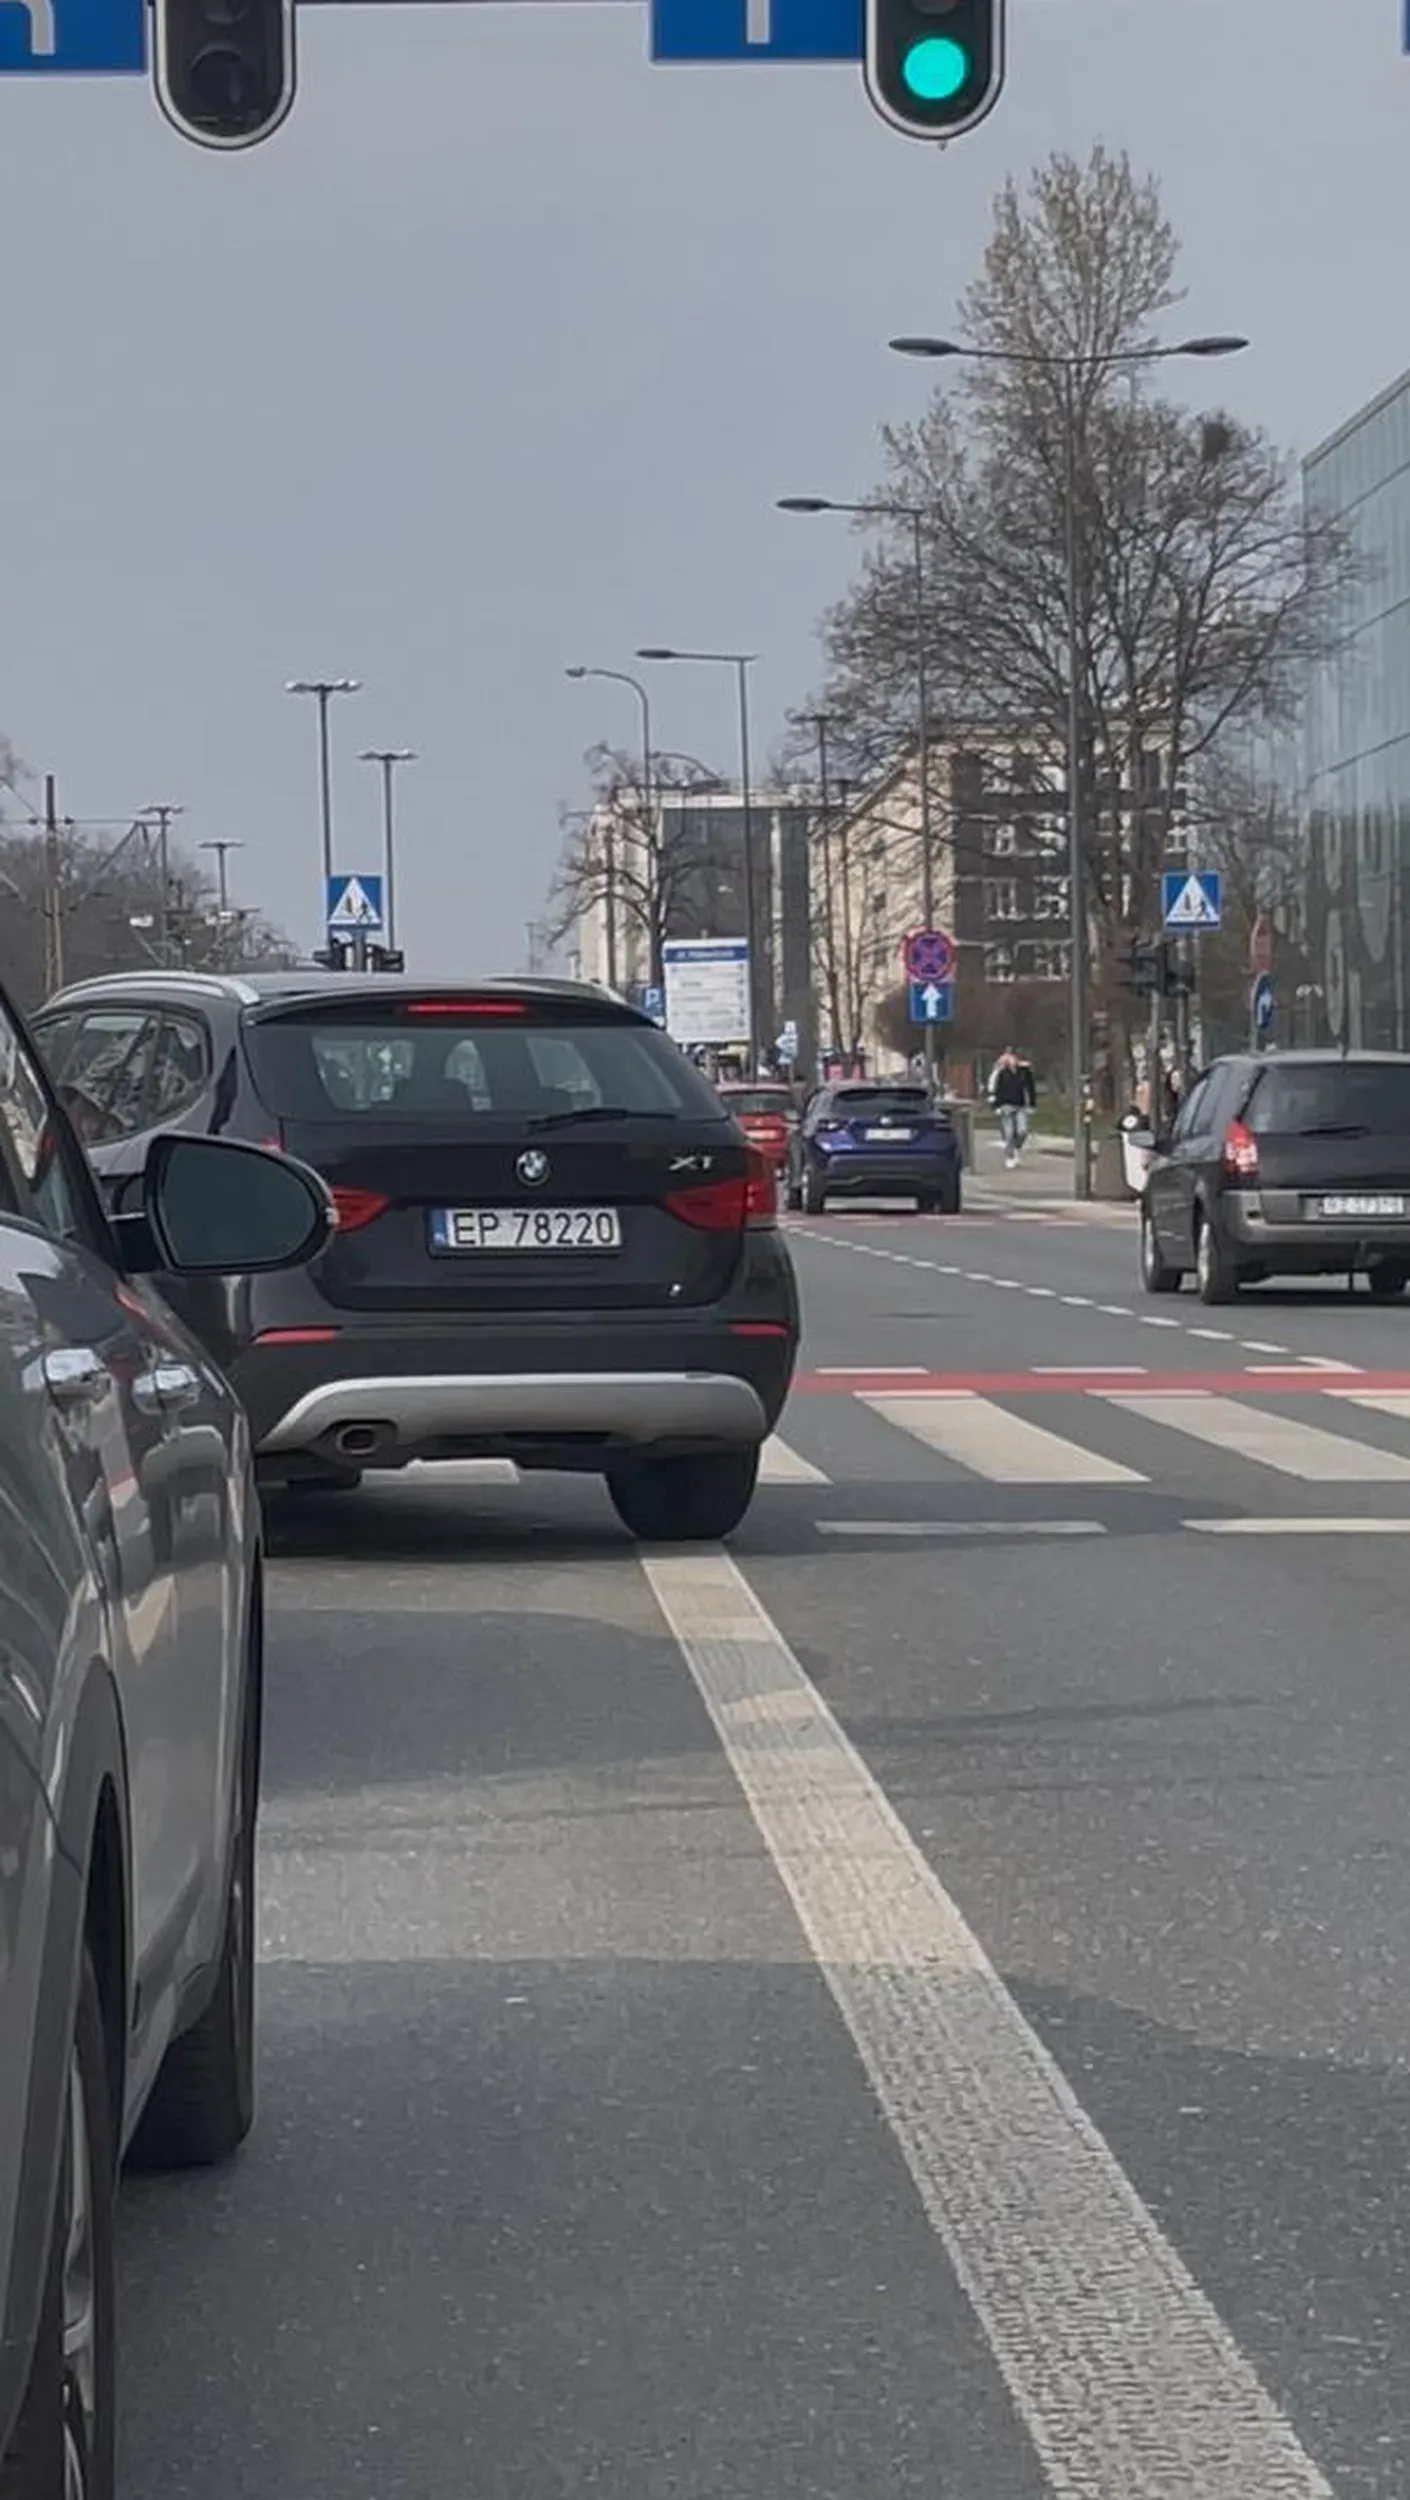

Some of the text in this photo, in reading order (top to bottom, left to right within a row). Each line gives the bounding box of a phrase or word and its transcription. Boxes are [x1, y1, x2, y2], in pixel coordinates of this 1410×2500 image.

[668, 1155, 713, 1171] X1
[453, 1212, 615, 1246] EP 78220
